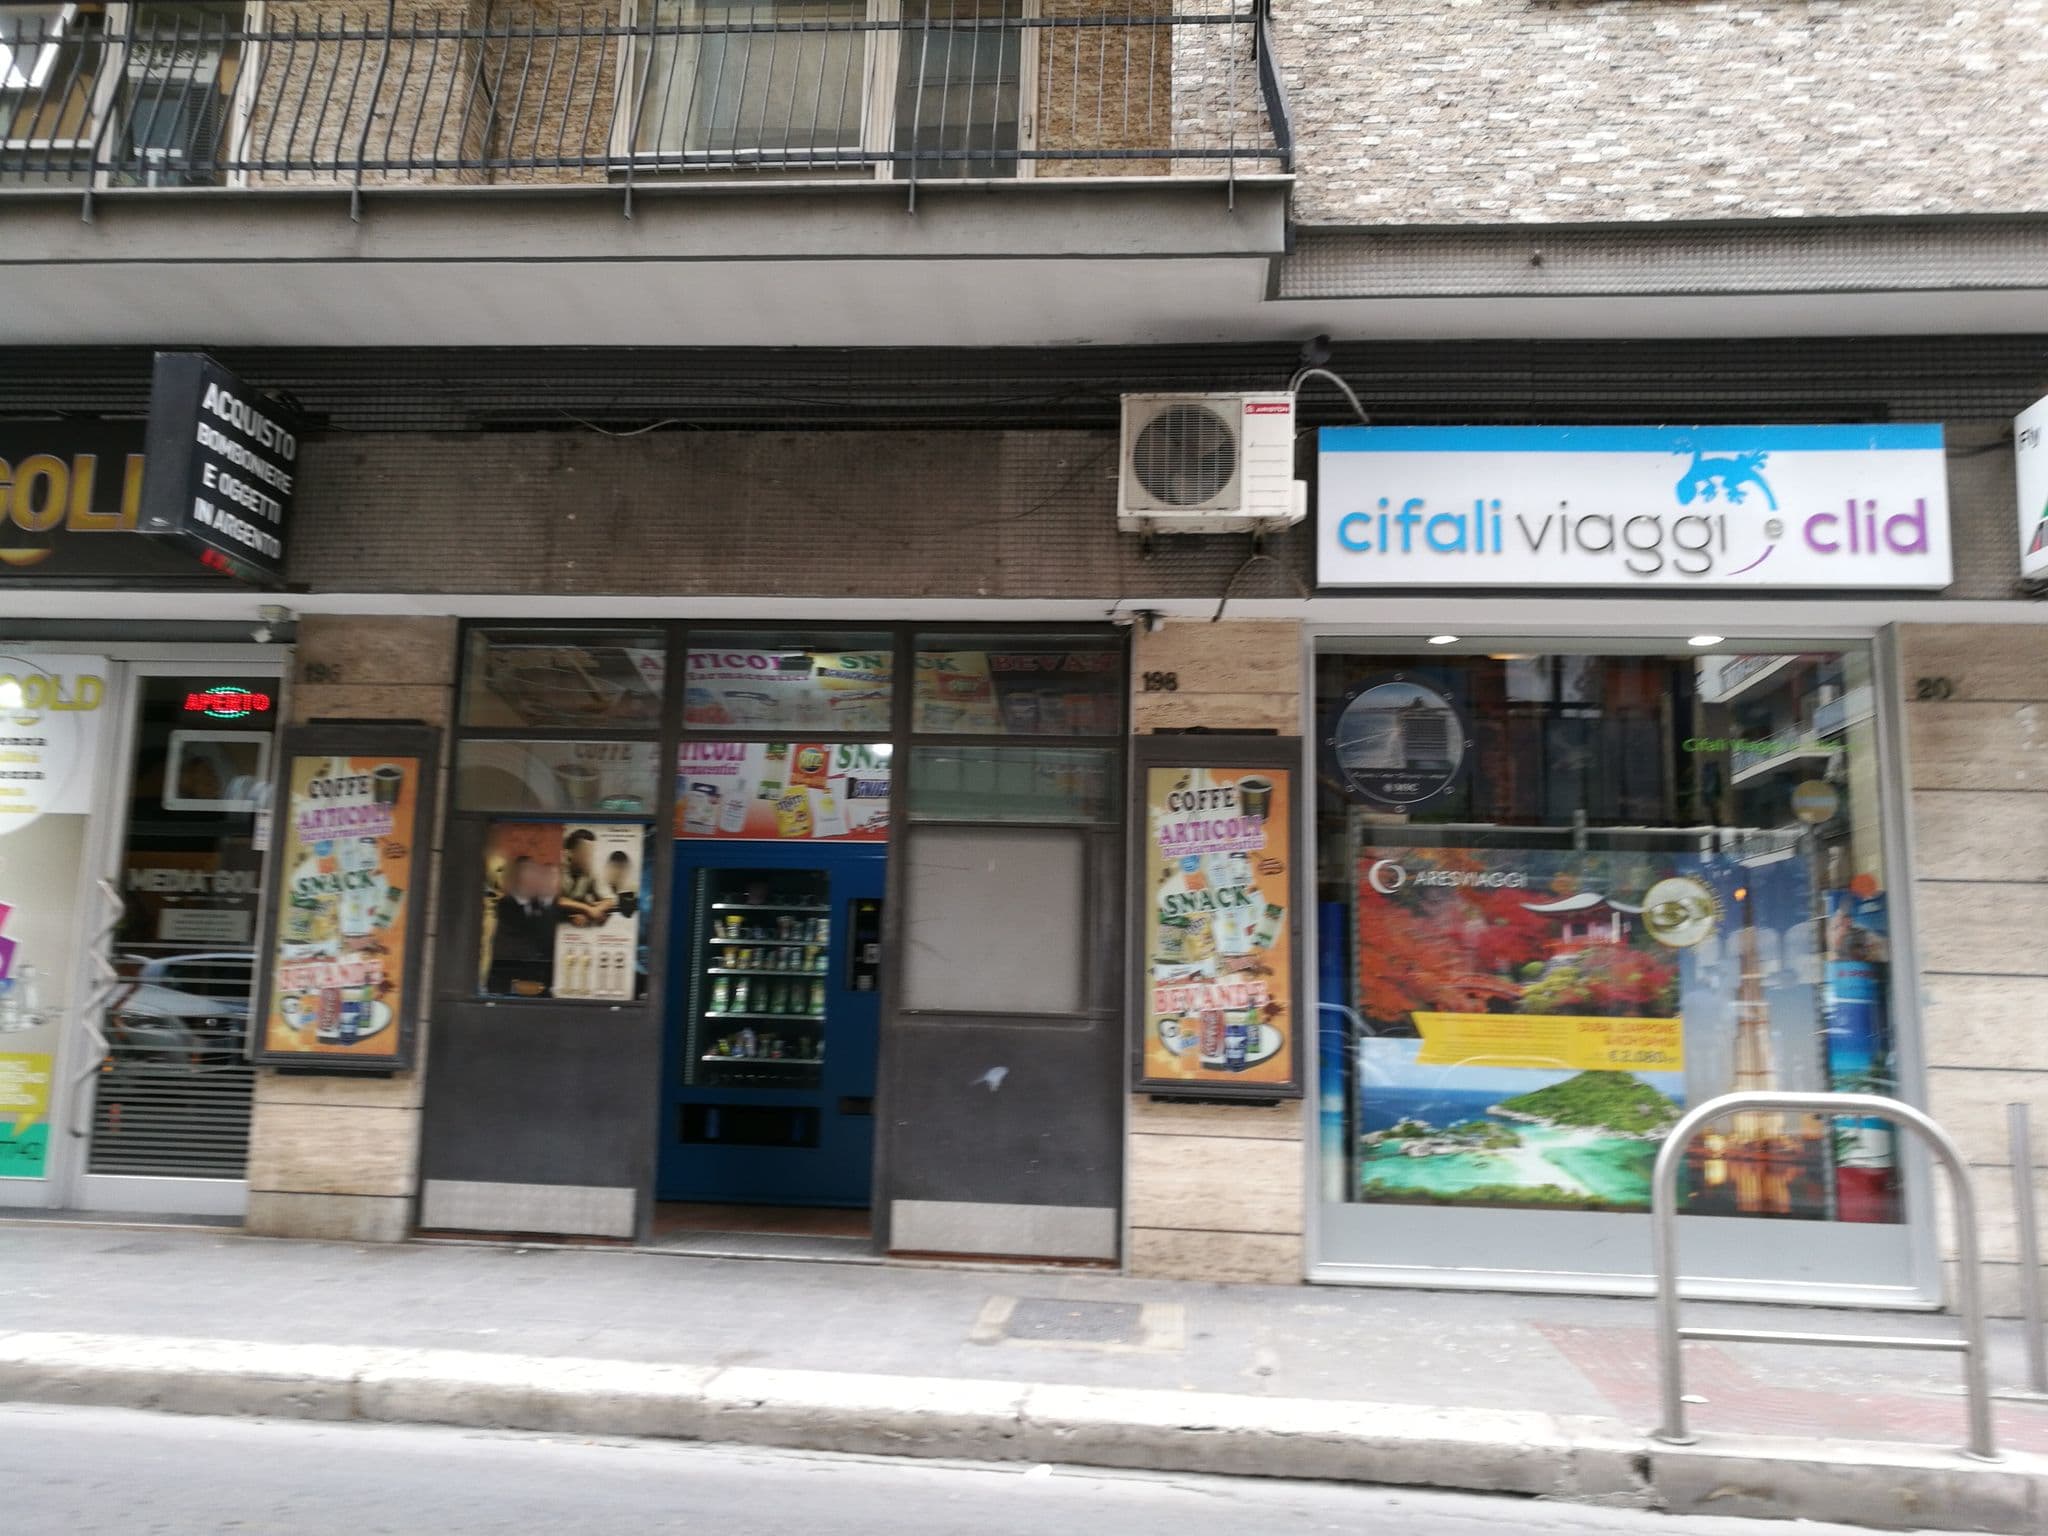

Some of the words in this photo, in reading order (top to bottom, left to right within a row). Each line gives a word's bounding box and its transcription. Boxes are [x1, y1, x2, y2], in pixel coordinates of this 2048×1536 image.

[202, 383, 296, 461] ACQUISTO
[196, 422, 294, 495] BOMBONIERE
[0, 453, 145, 532] OL
[202, 462, 219, 489] E
[218, 472, 282, 524] OGGETTI
[193, 497, 215, 526] IN
[212, 508, 282, 559] ARGENTO
[1337, 497, 1503, 553] cifali
[1515, 501, 1727, 575] viaggi
[1763, 518, 1784, 540] e
[1803, 498, 1927, 555] clid
[0, 673, 105, 712] OLD
[184, 693, 270, 712] APERTO
[309, 775, 370, 799] COFFE
[1167, 786, 1236, 813] COFFE
[1158, 814, 1263, 846] ARTICOLI
[297, 868, 377, 897] SNACK
[1163, 884, 1252, 916] SNACK
